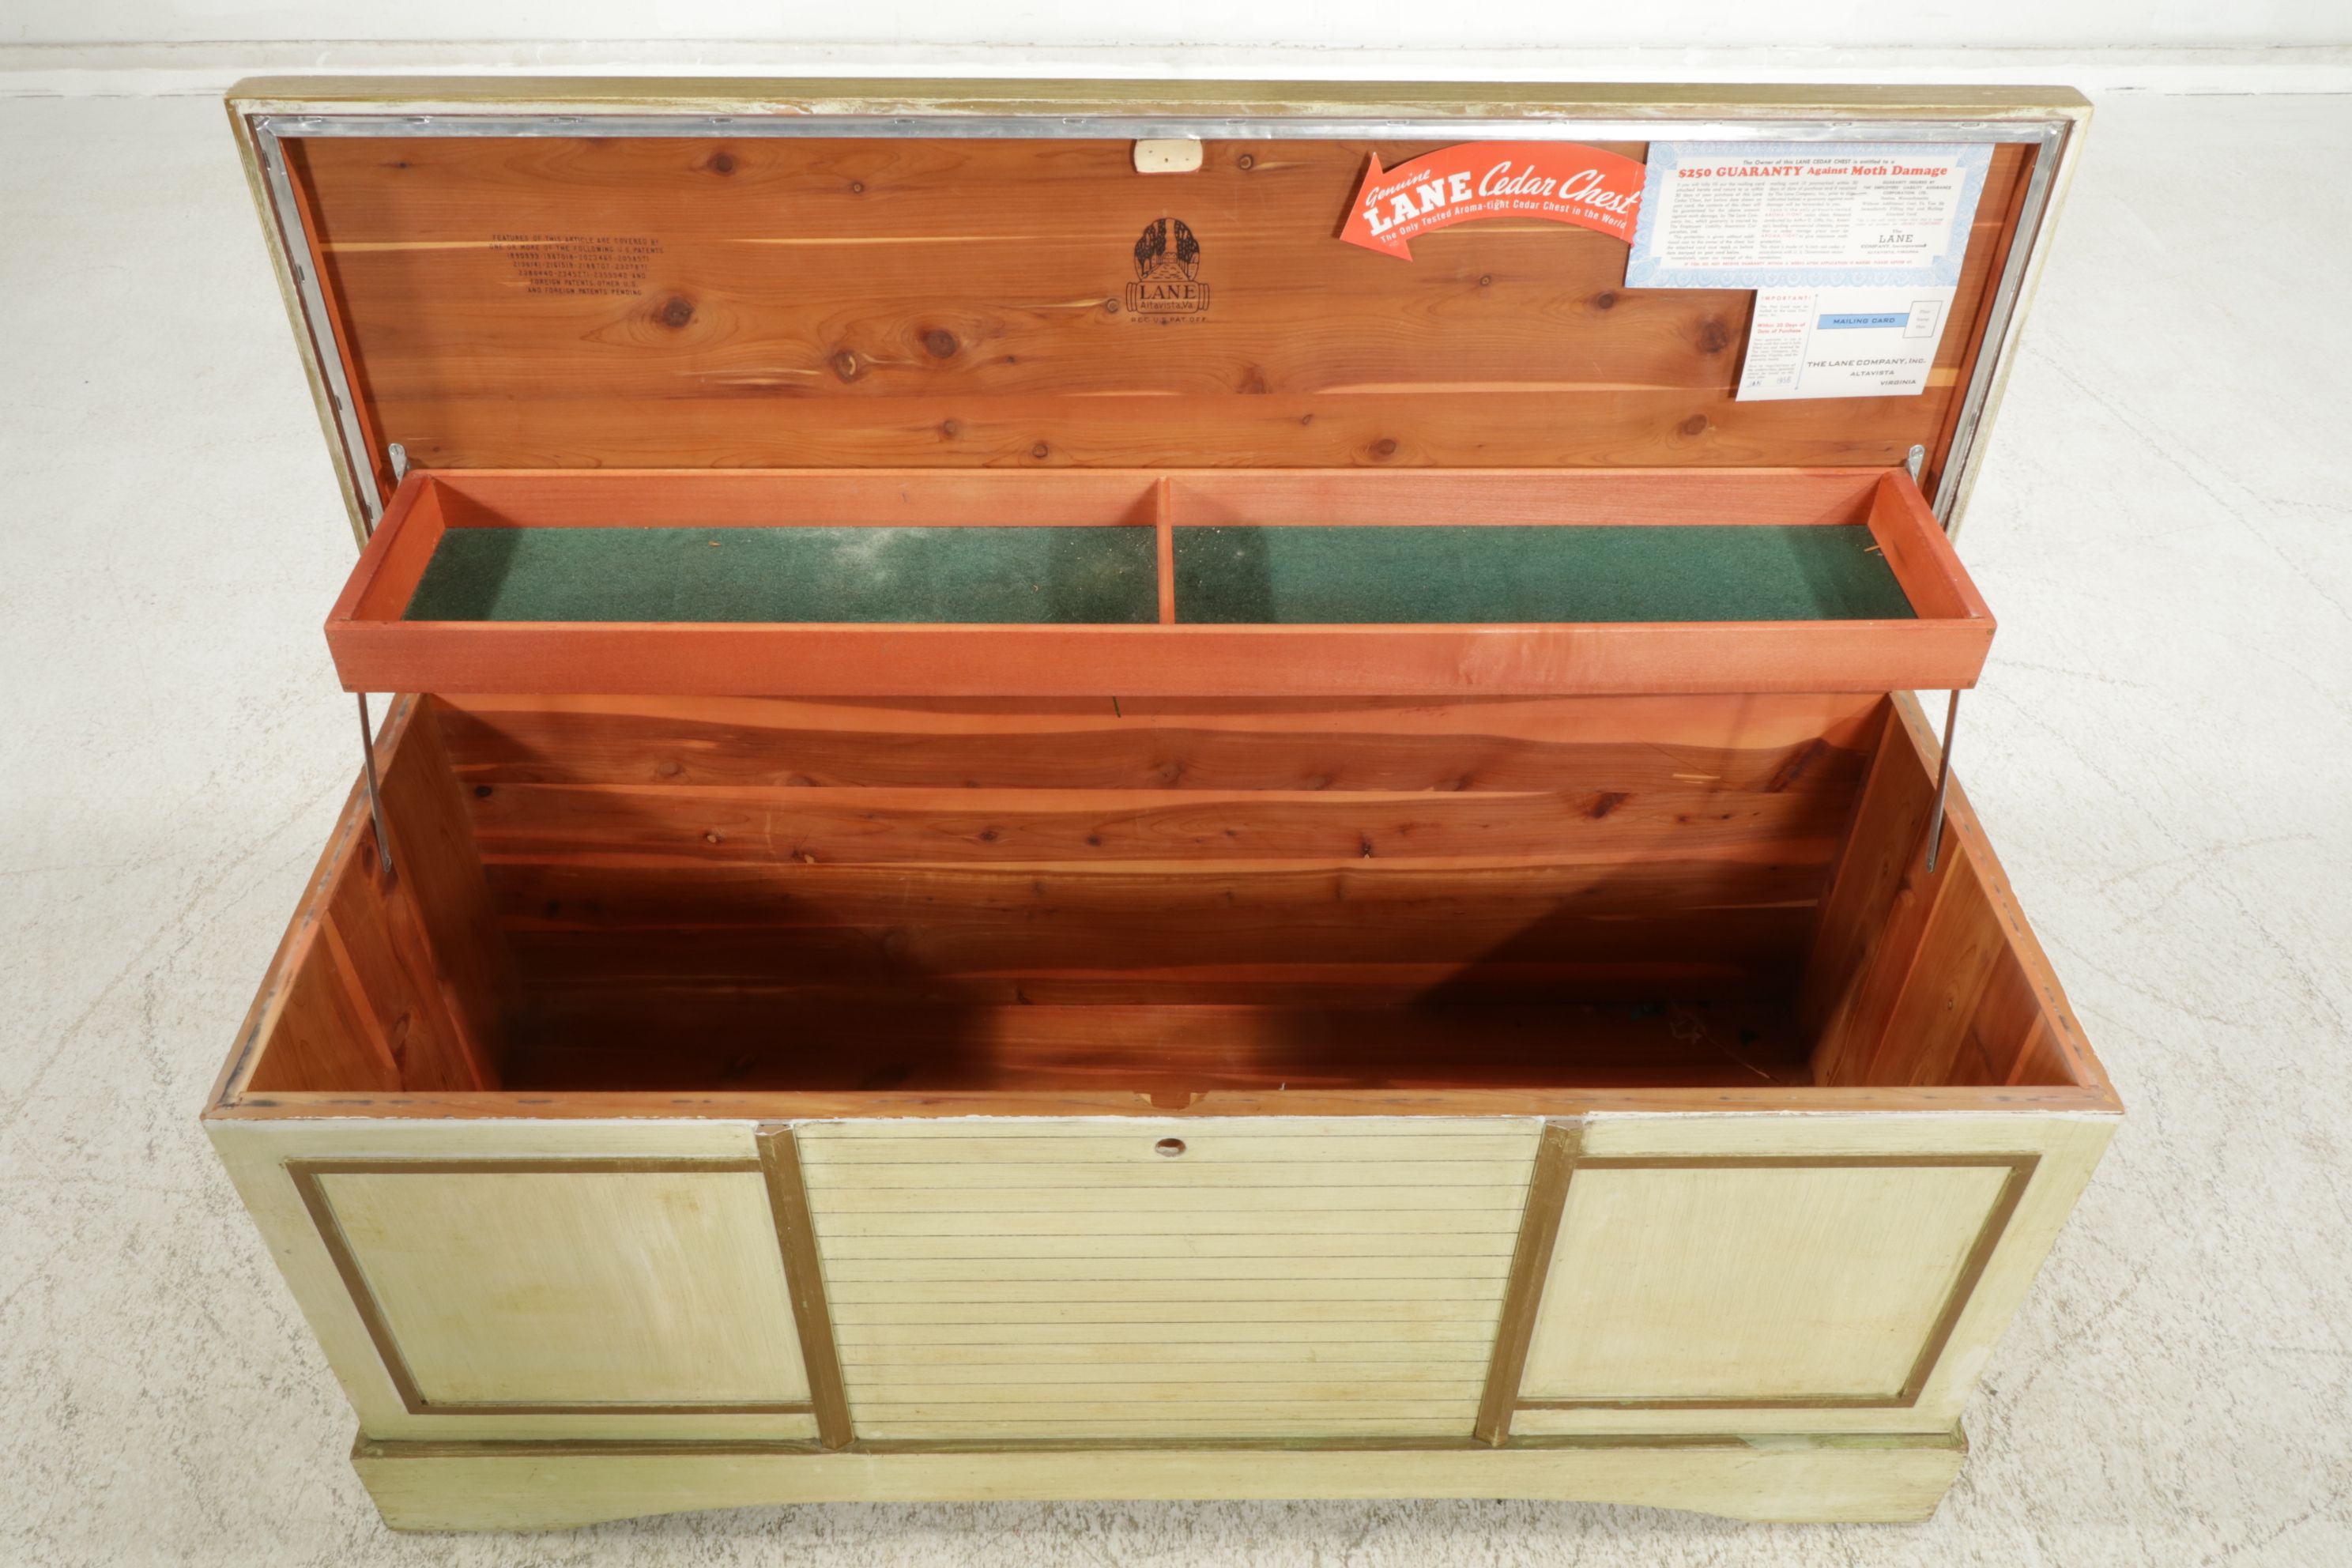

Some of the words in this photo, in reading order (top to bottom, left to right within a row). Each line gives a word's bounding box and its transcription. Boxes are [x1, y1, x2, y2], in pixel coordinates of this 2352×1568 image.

[1366, 169, 1431, 207] Genuine
[1479, 161, 1559, 197] Cedar
[1679, 168, 1712, 178] $250
[1717, 166, 1804, 177] GUARANTY
[1807, 167, 1848, 175] Against
[1851, 165, 1887, 175] Moth
[1891, 165, 1948, 177] Damage
[1363, 172, 1472, 236] LANE
[1559, 169, 1640, 214] Chest
[1380, 232, 1397, 244] The
[1400, 221, 1419, 235] Only
[1422, 211, 1451, 227] Tested
[1455, 199, 1509, 216] Aroma-tight
[1513, 200, 1539, 209] Cedar
[1544, 201, 1570, 213] Chest
[1572, 205, 1581, 215] in
[1584, 207, 1600, 220] the
[1603, 213, 1627, 230] World
[1879, 235, 1914, 243] LANE
[1140, 285, 1196, 300] LANE
